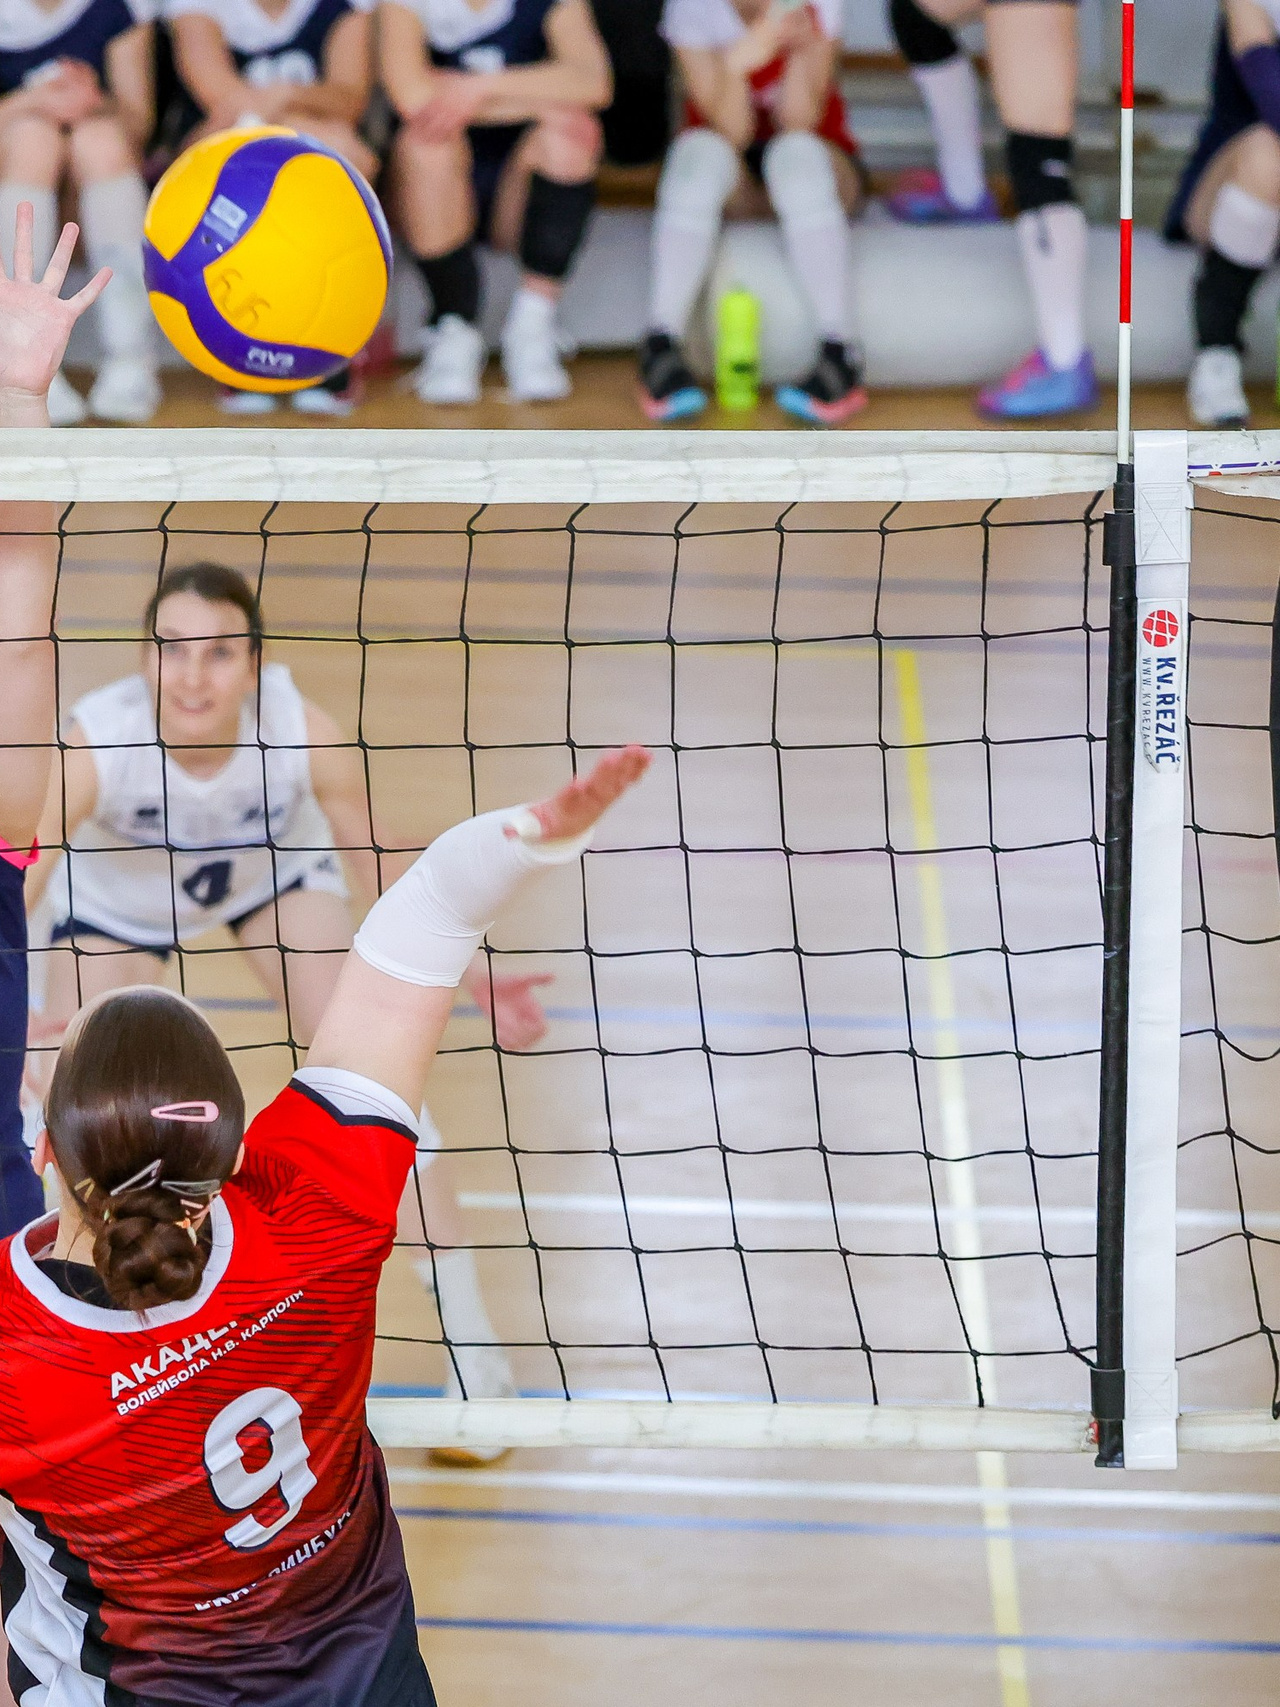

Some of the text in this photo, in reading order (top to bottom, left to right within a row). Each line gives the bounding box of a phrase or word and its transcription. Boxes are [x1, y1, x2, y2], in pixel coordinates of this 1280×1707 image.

[1155, 657, 1181, 764] KV.ŘEZÁČ
[116, 1358, 210, 1416] ВОЛЕЙБОЛА
[211, 1339, 239, 1361] Н.В.
[202, 1386, 318, 1551] 9
